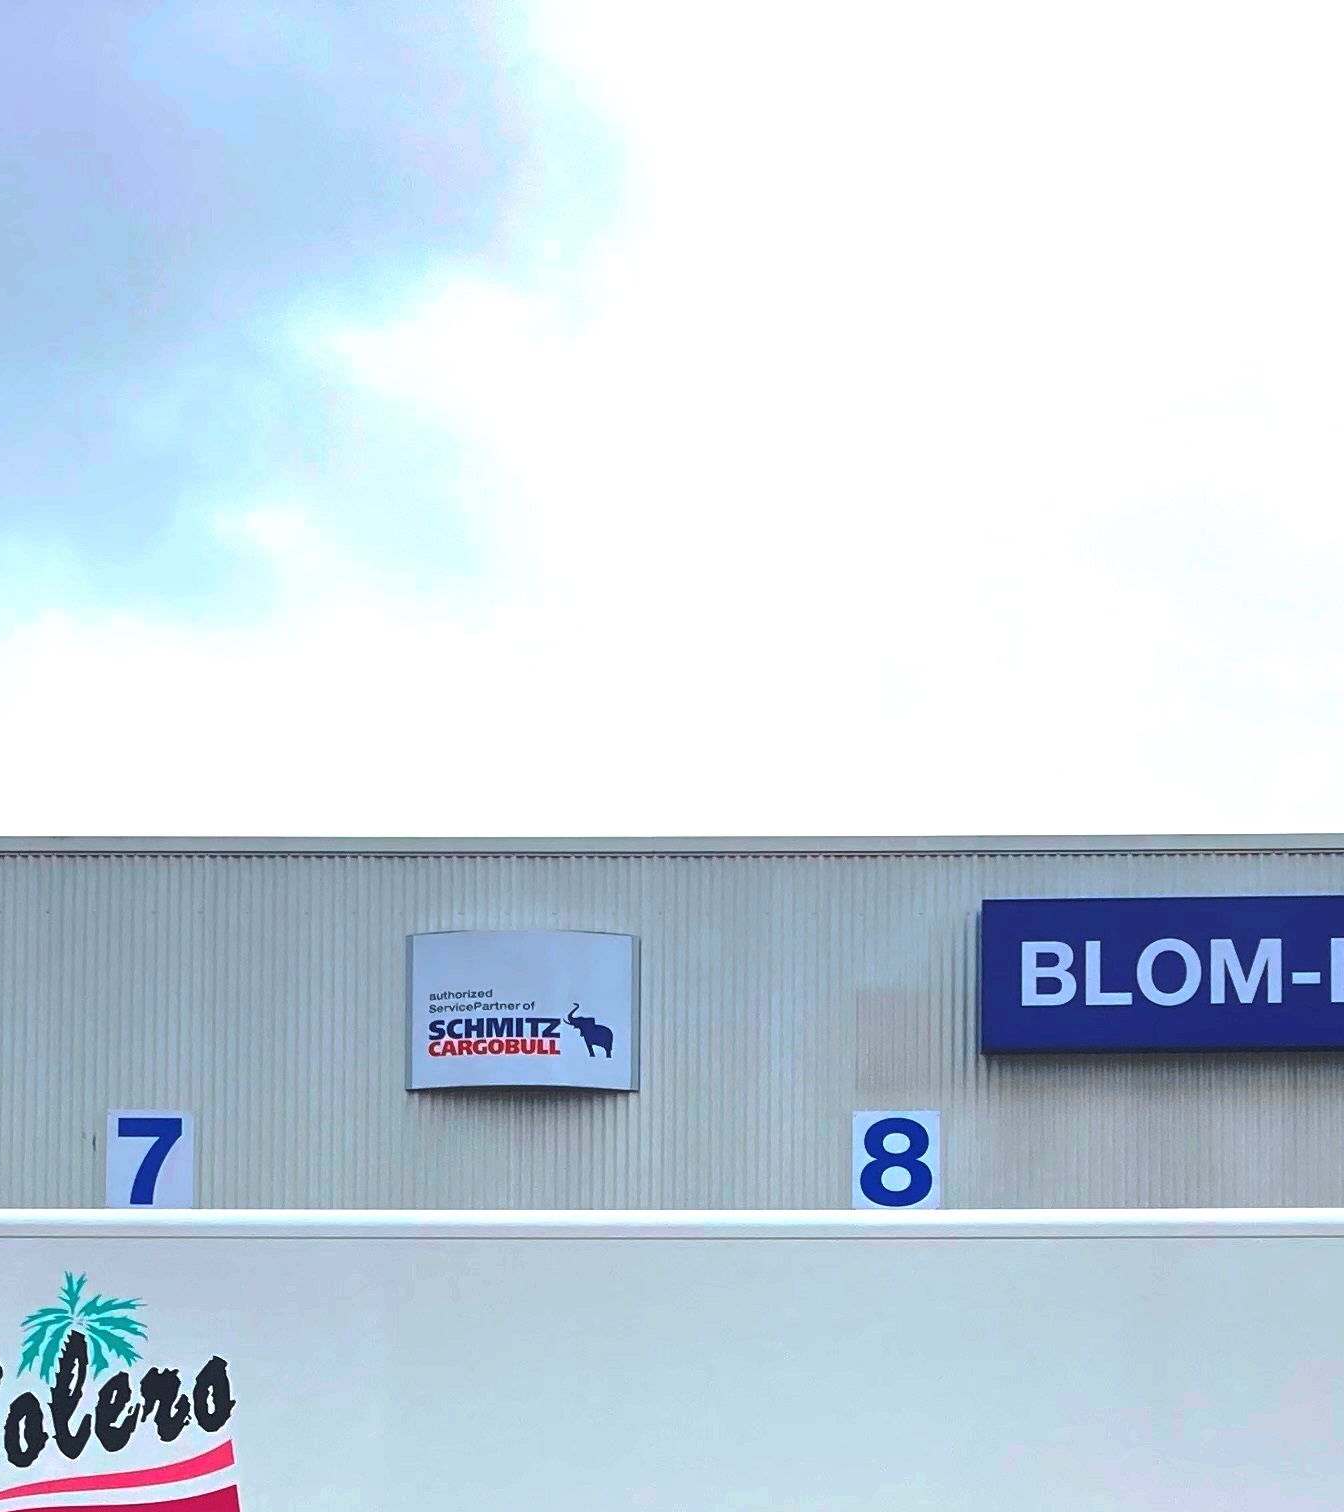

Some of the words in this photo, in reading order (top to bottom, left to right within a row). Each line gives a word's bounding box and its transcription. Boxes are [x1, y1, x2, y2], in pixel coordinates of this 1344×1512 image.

[429, 988, 493, 1001] authorized
[428, 1001, 521, 1014] ServicePartner
[523, 1001, 536, 1011] of
[428, 1017, 561, 1040] SCHMITZ
[428, 1039, 561, 1057] CARGOBULL
[117, 1117, 184, 1206] 7
[860, 1117, 932, 1207] 8
